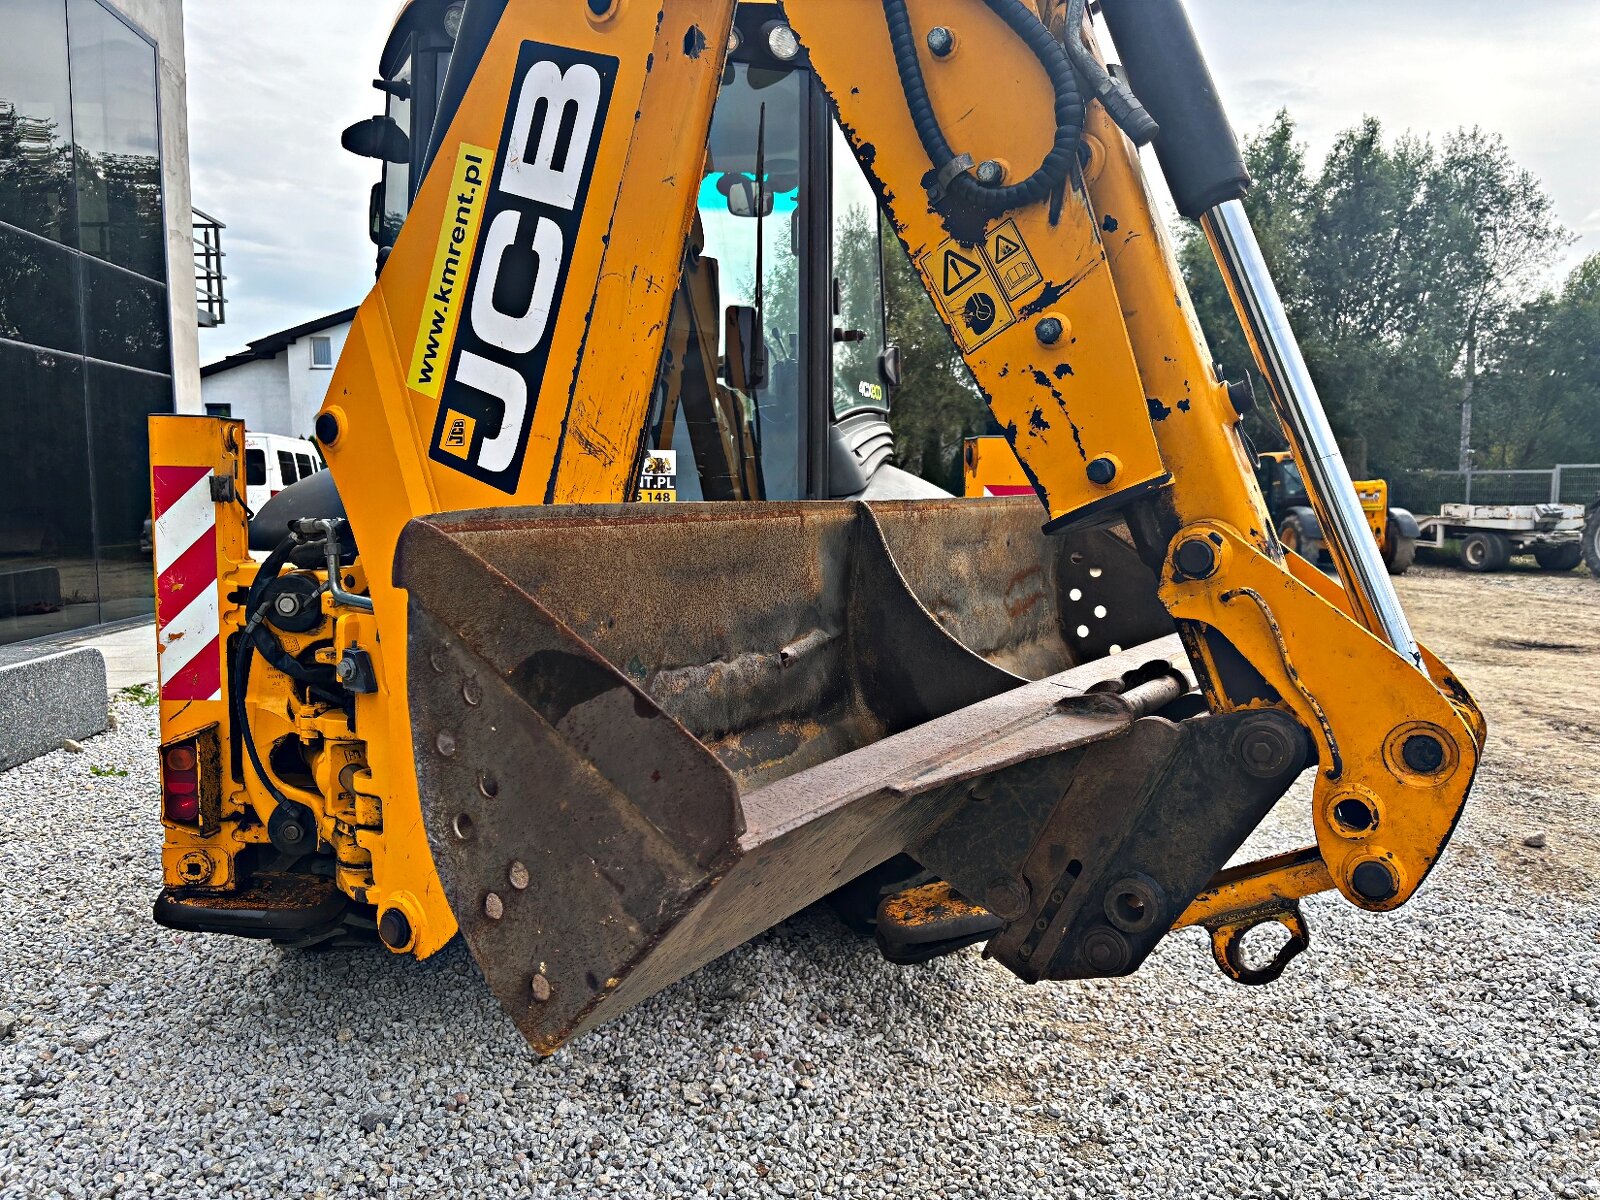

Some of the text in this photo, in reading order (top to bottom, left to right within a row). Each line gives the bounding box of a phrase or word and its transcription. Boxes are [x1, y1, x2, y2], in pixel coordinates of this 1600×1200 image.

[418, 154, 483, 384] www.kmrent.pl
[455, 60, 600, 472] JCB
[447, 420, 465, 445] JCB
[647, 492, 670, 501] 148
